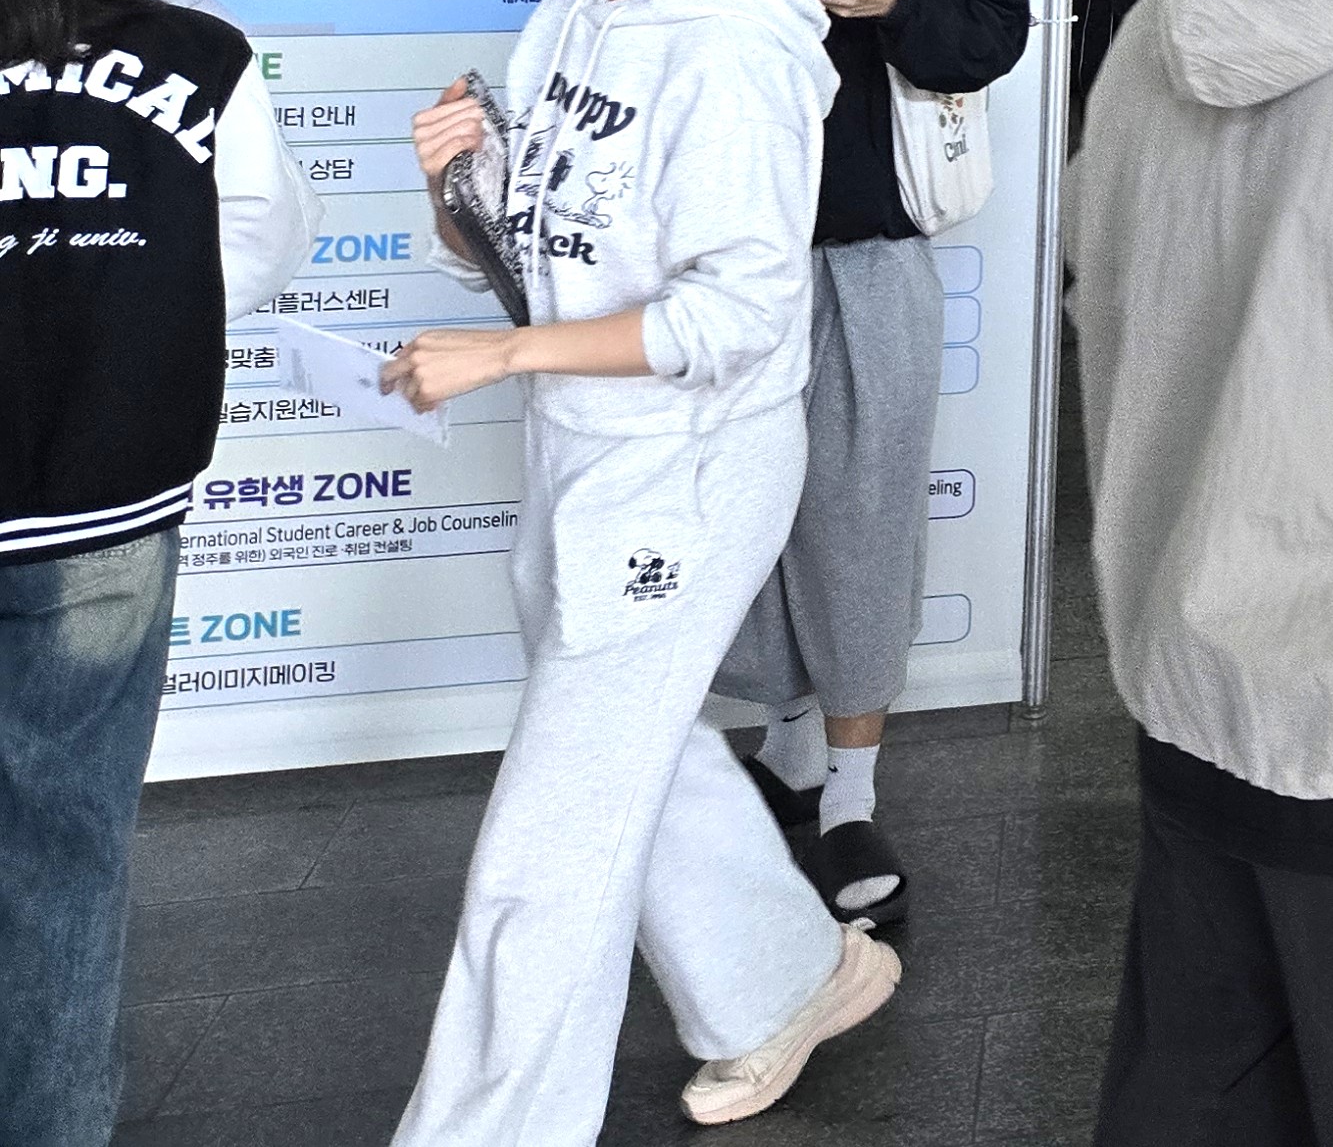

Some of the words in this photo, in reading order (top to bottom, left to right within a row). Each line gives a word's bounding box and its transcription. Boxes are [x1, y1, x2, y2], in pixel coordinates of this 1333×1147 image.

[311, 105, 356, 128] 안내
[309, 158, 355, 181] 상담
[69, 227, 147, 247] univ.
[311, 232, 411, 264] ZONE
[203, 474, 304, 510] 유학생
[313, 469, 412, 501] ZONE
[928, 479, 962, 497] eling
[181, 526, 262, 549] ernational
[266, 523, 331, 544] Student
[334, 518, 389, 539] Career
[392, 517, 404, 535] &
[408, 515, 437, 534] Job
[441, 510, 518, 532] Counselin
[201, 608, 302, 643] ZONE
